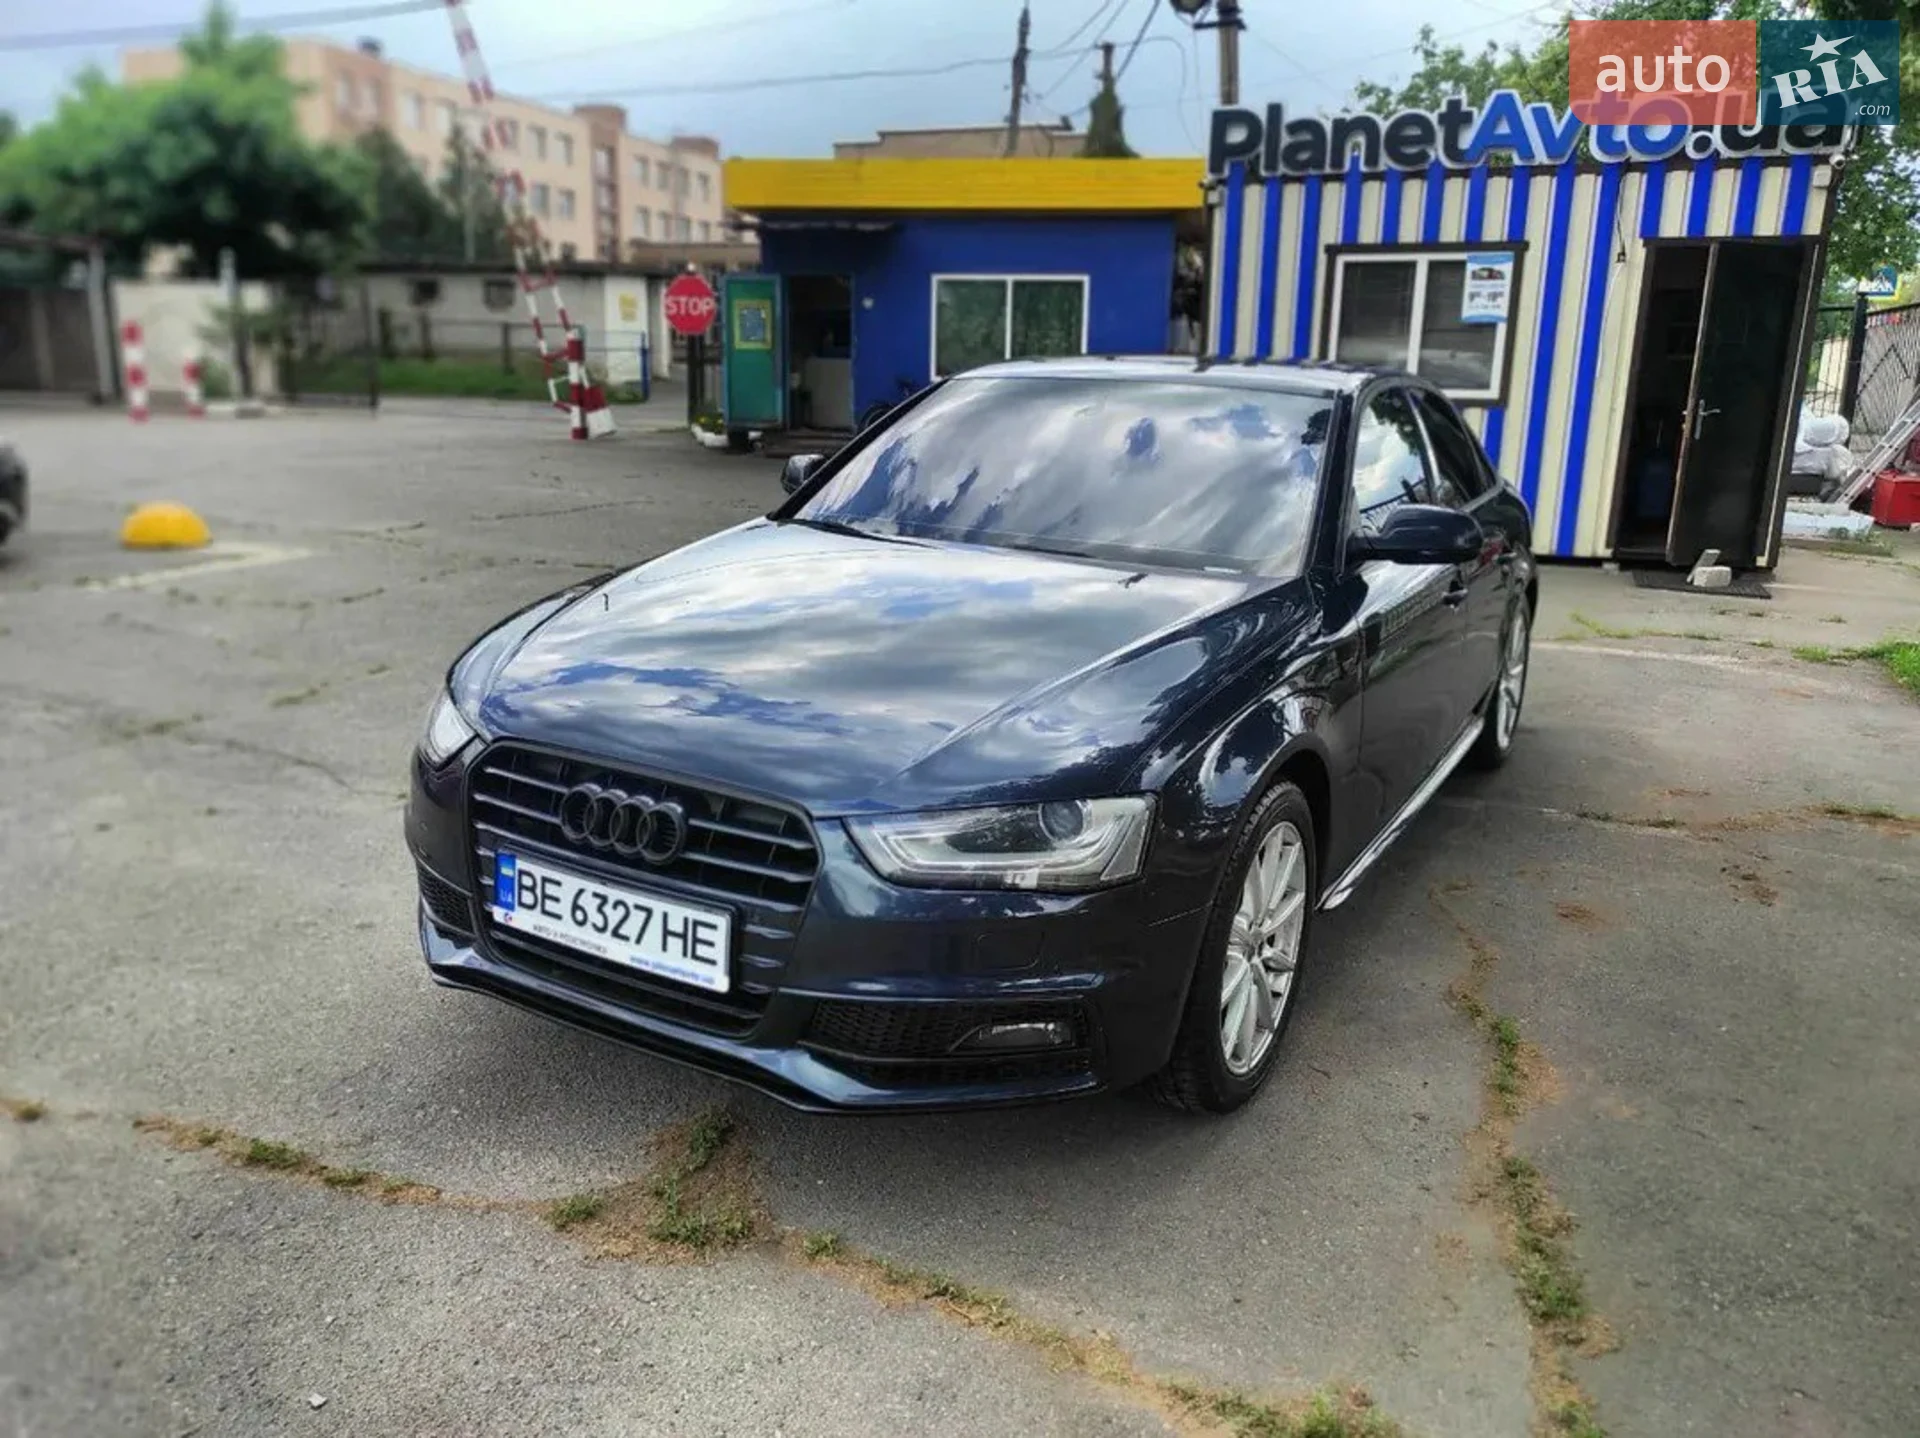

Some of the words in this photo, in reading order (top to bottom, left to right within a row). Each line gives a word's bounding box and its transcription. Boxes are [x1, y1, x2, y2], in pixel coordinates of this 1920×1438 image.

[667, 296, 714, 316] STOP
[517, 869, 563, 921] BE
[570, 888, 653, 945] 6327
[661, 911, 718, 966] HE
